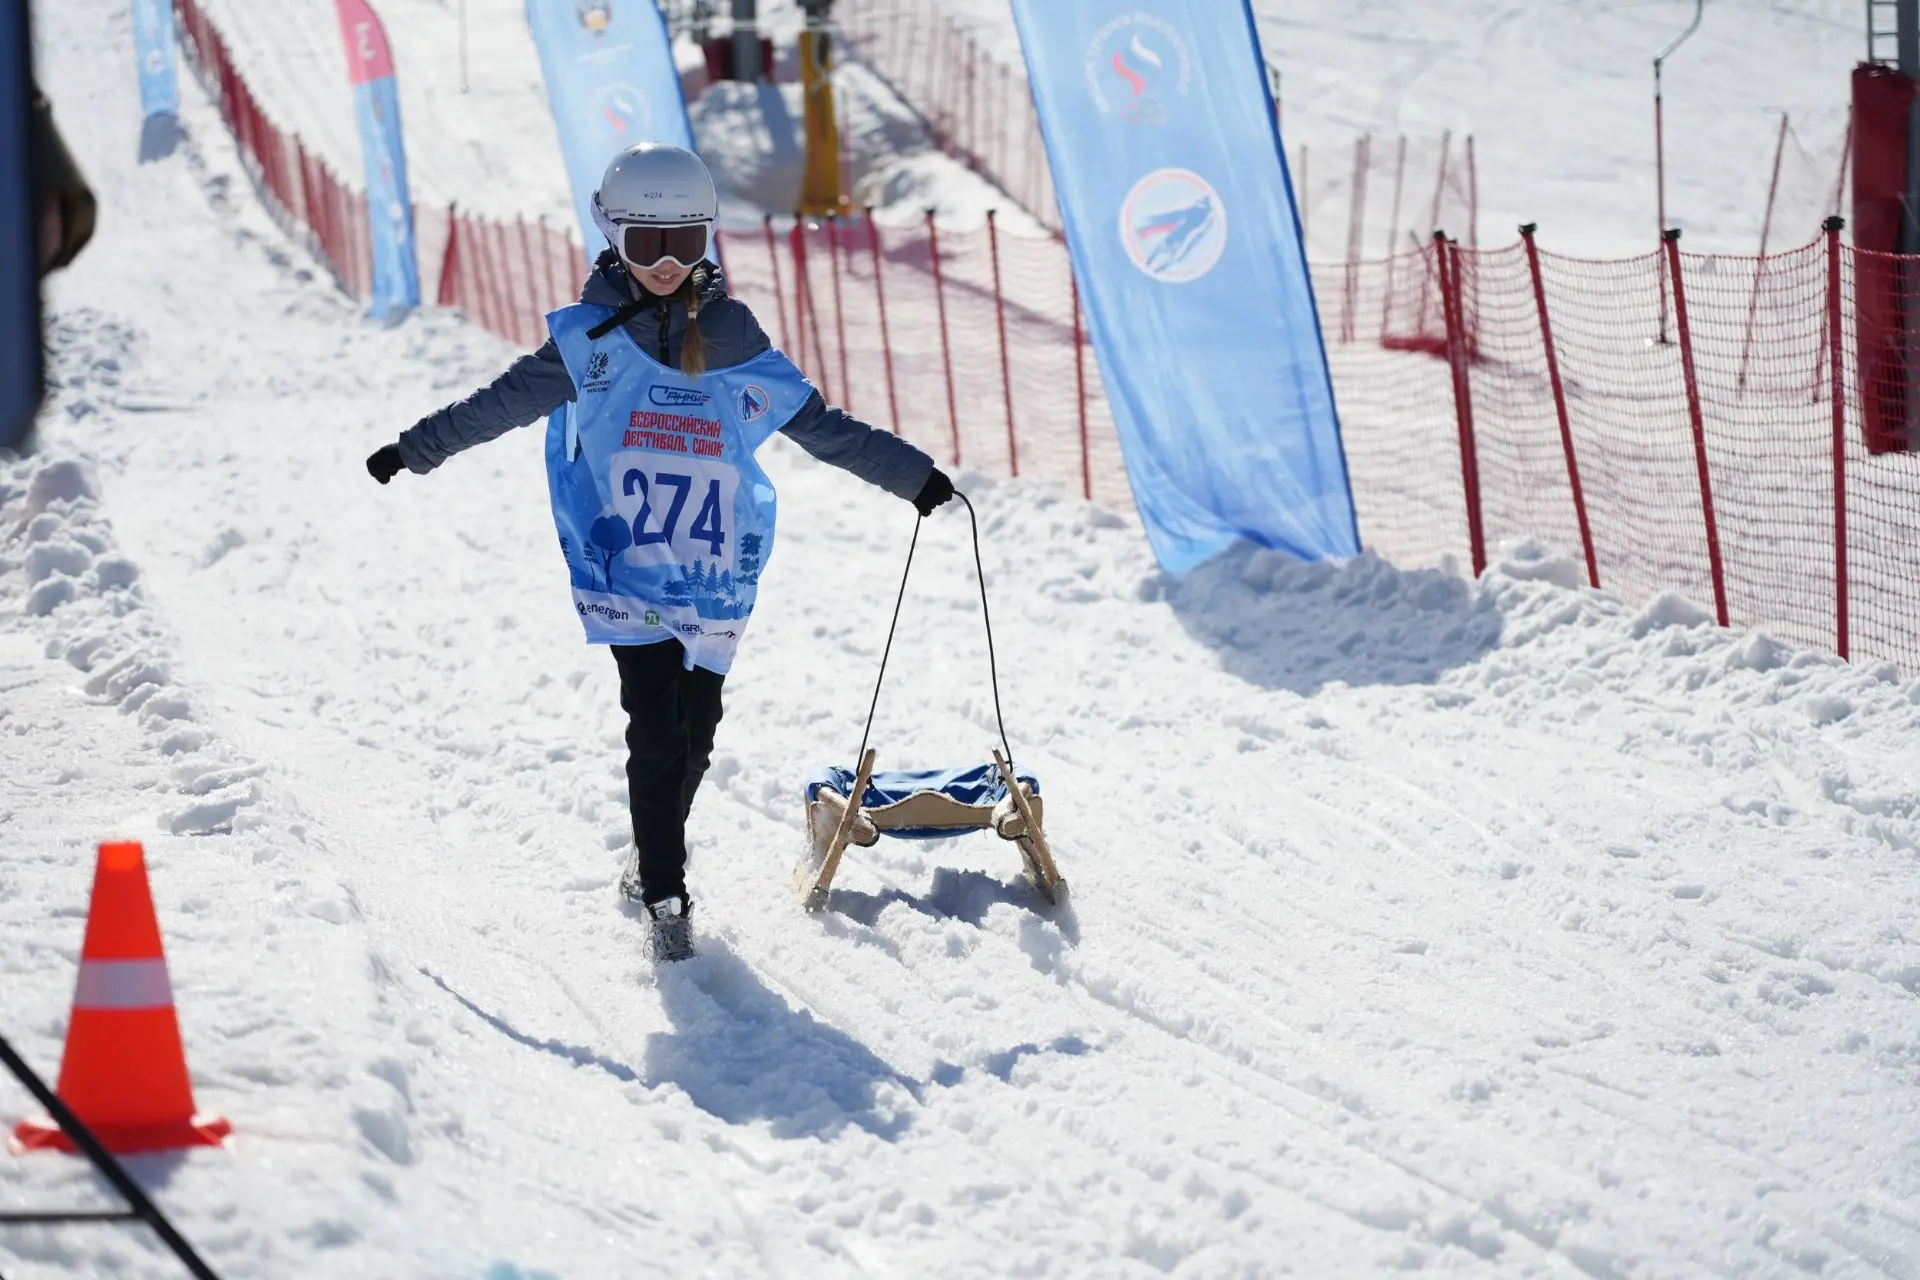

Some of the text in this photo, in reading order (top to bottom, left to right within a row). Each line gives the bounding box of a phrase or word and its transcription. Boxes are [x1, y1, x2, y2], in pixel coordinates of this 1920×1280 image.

[629, 411, 721, 438] ВСЕРОССИЙСКИЙ
[622, 429, 724, 457] ФЕСТИВАЛЬ САНОК
[623, 468, 725, 557] 274
[586, 604, 629, 620] energon
